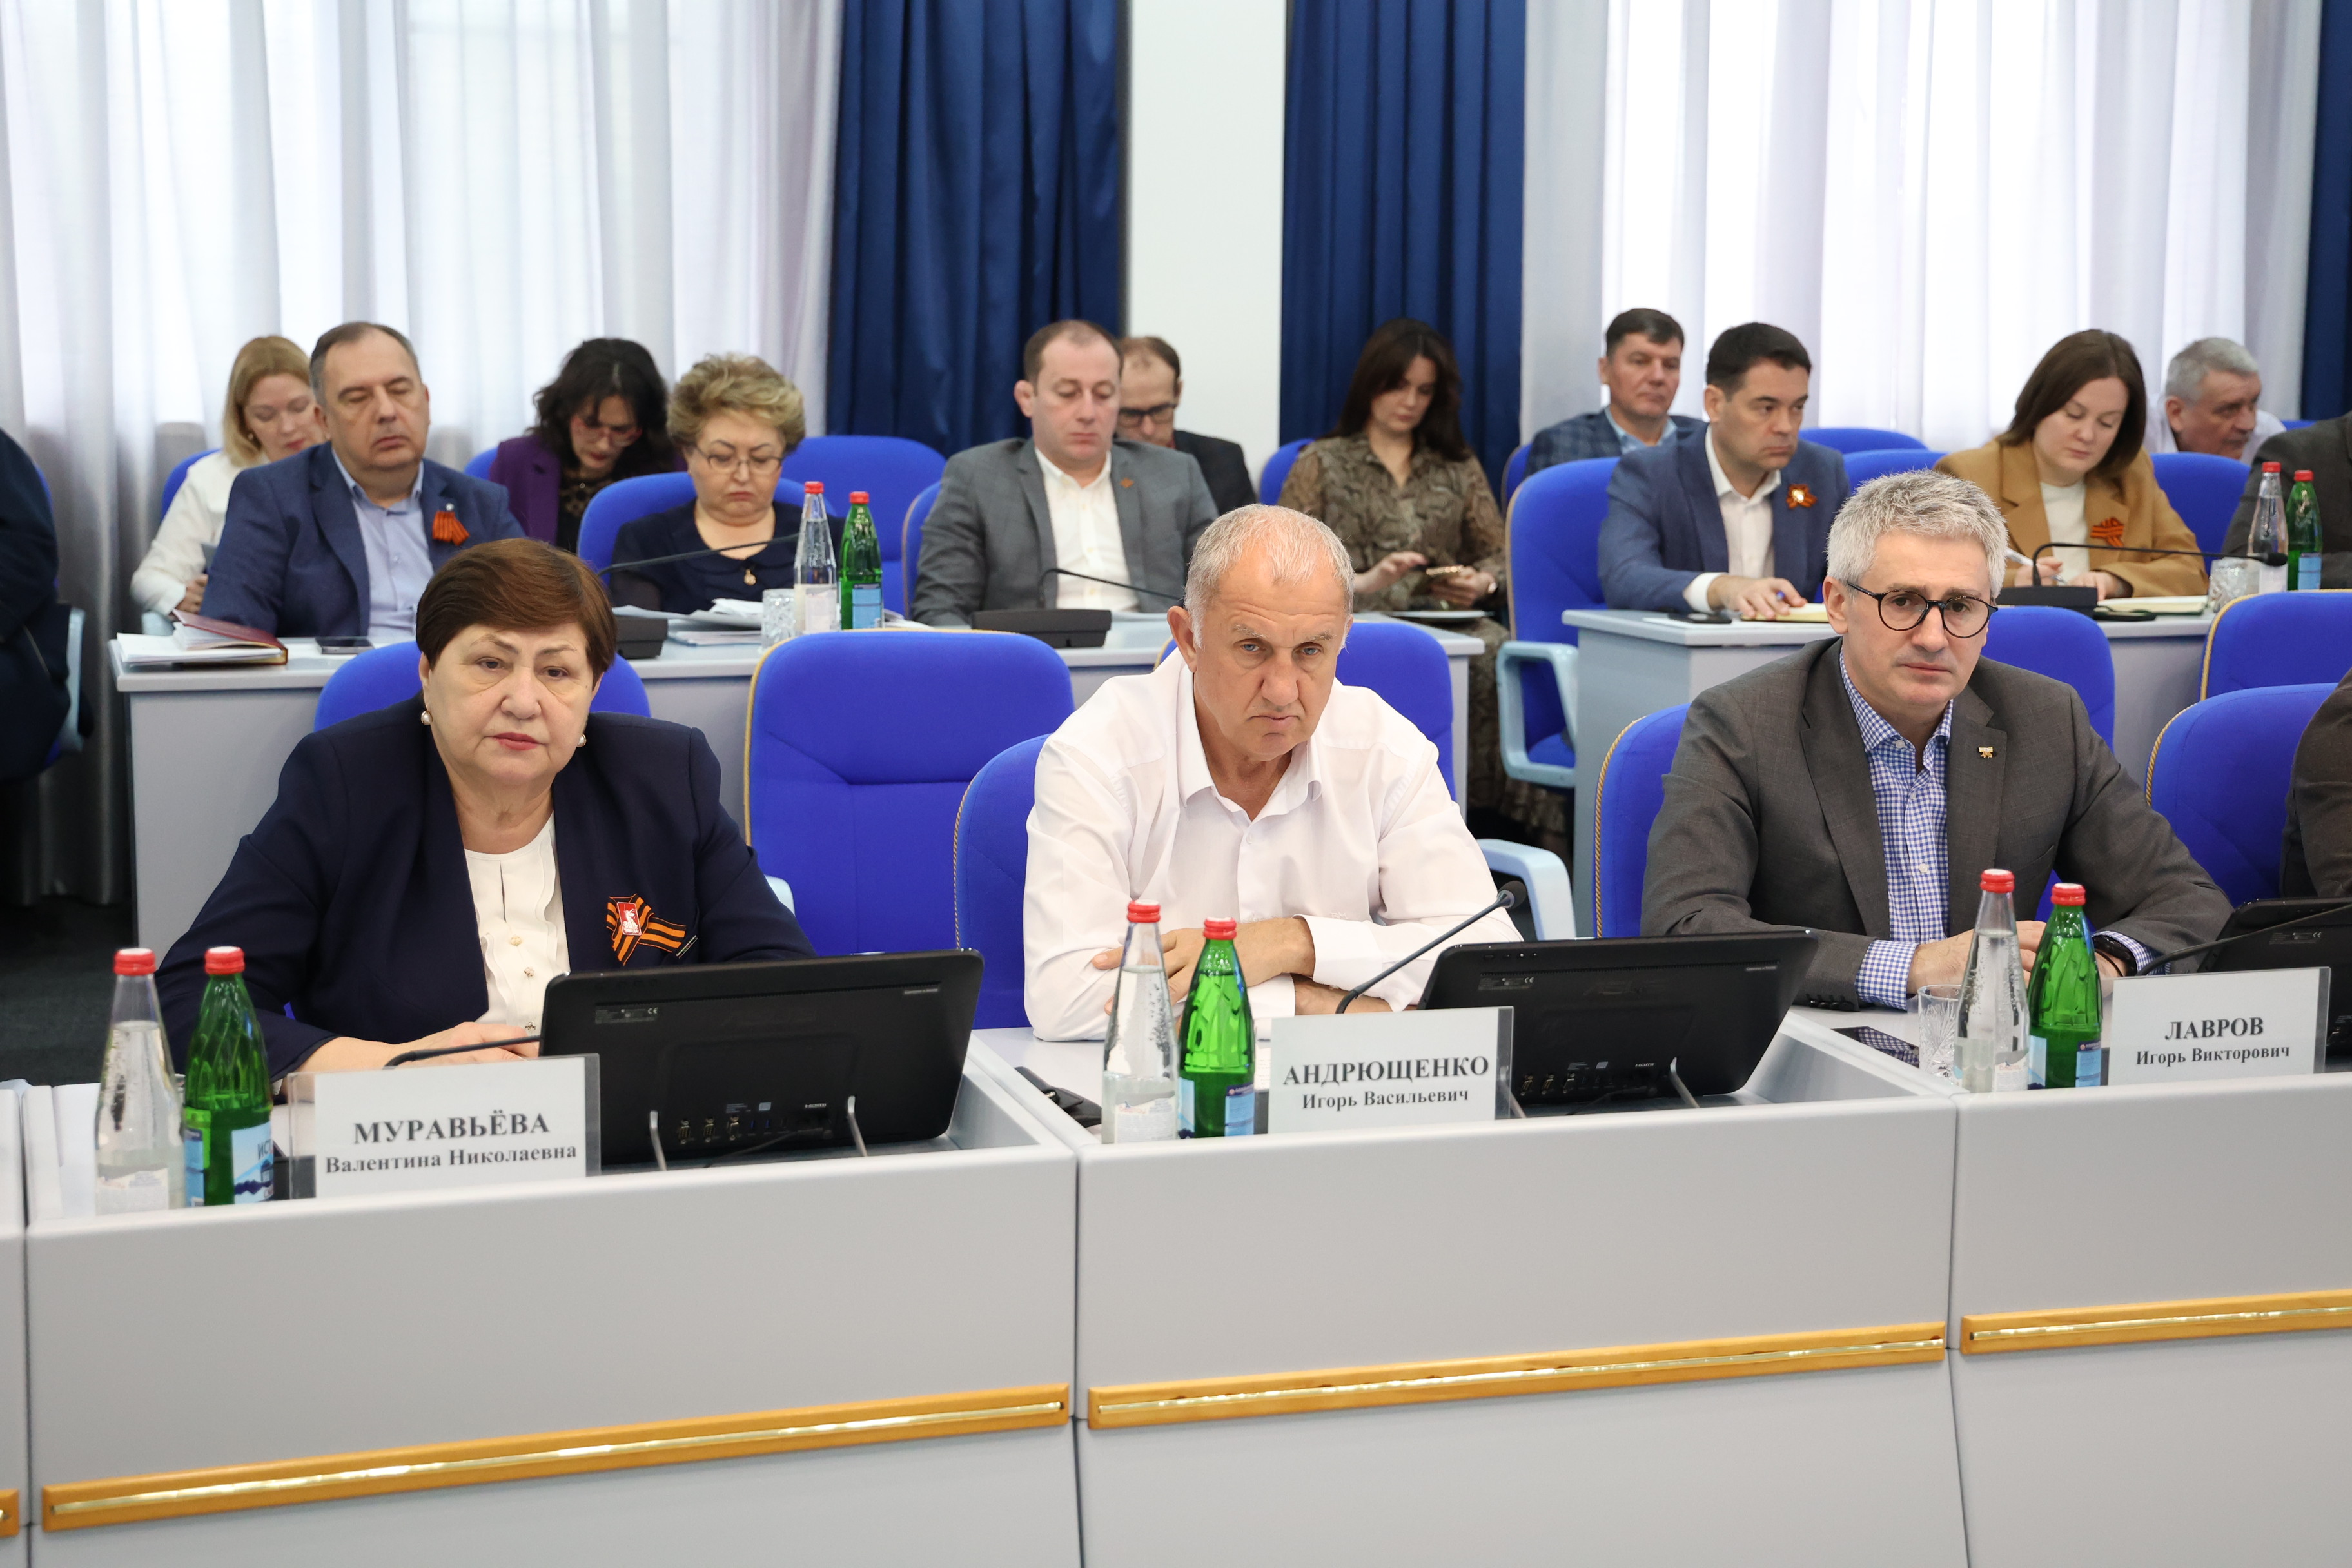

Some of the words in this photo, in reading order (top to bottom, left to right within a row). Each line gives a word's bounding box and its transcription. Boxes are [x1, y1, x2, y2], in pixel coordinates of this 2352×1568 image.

[2164, 1017, 2264, 1041] ЛАВРОВ
[2135, 1050, 2186, 1068] Игорь
[2191, 1046, 2290, 1063] Викторович
[1283, 1056, 1489, 1086] АНДРЮЩЕНКО
[1302, 1093, 1357, 1112] Игорь
[1364, 1090, 1469, 1106] Васильевич
[353, 1110, 550, 1144] МУРАВЬЁВА
[326, 1156, 441, 1173] Валентина
[449, 1146, 576, 1166] Николаевна
